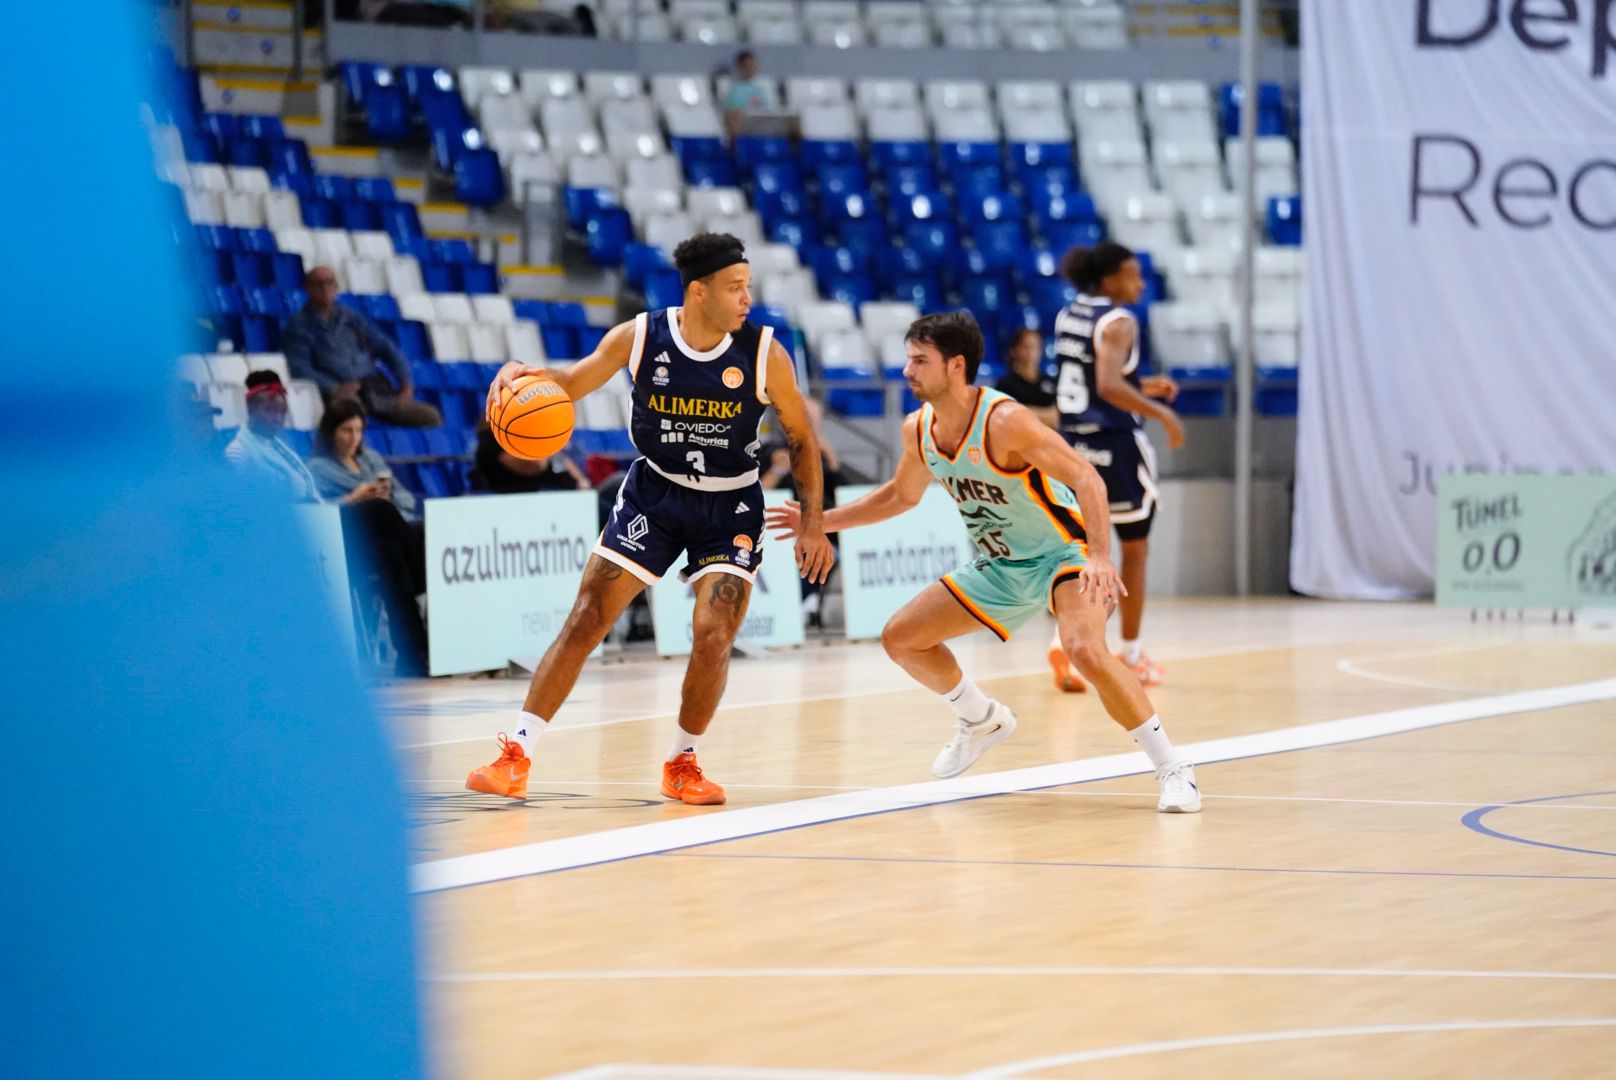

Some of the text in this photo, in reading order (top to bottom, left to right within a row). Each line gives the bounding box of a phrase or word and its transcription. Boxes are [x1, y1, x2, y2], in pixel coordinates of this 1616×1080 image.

[648, 393, 742, 419] ALIMERKA
[675, 422, 727, 434] OVIEDO
[688, 433, 729, 446] Asturias
[686, 450, 706, 474] 3
[441, 523, 587, 584] azulmarino
[977, 530, 1011, 559] 15
